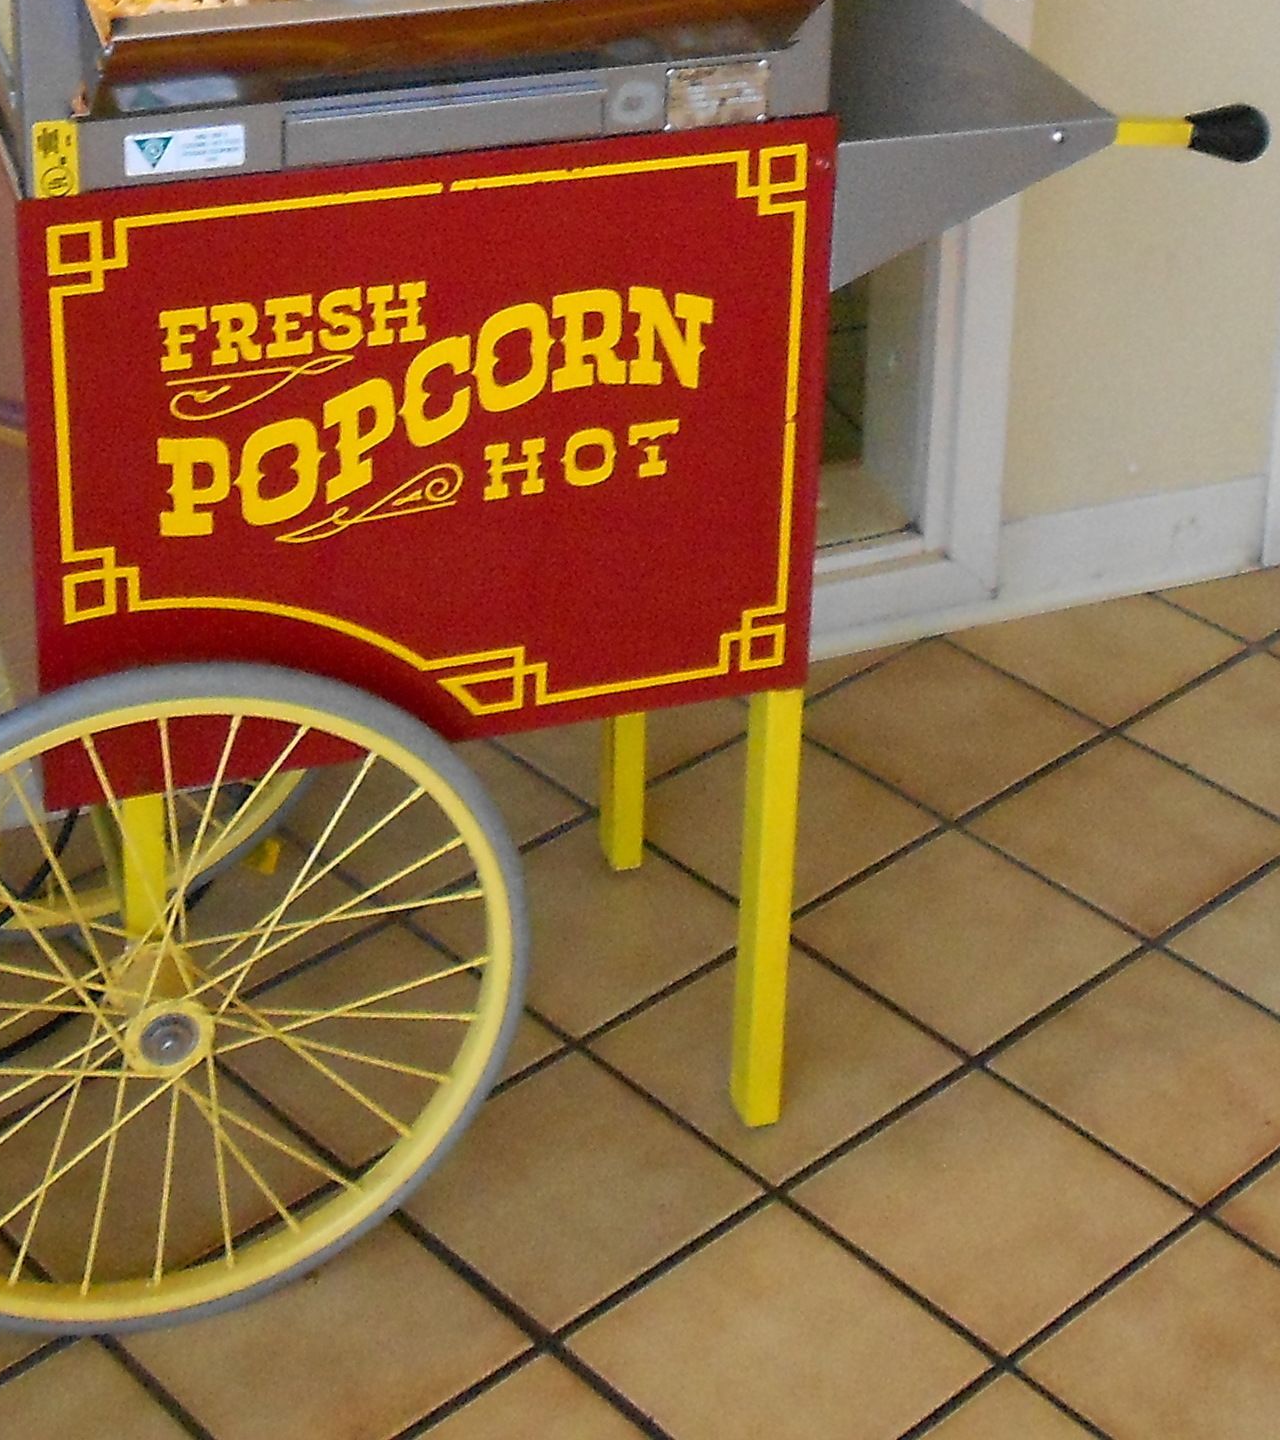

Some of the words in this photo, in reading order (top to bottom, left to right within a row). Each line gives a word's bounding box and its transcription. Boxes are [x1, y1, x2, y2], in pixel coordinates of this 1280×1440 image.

[158, 280, 428, 373] FRESH
[156, 285, 715, 538] POPCORN
[482, 417, 681, 503] HOT
